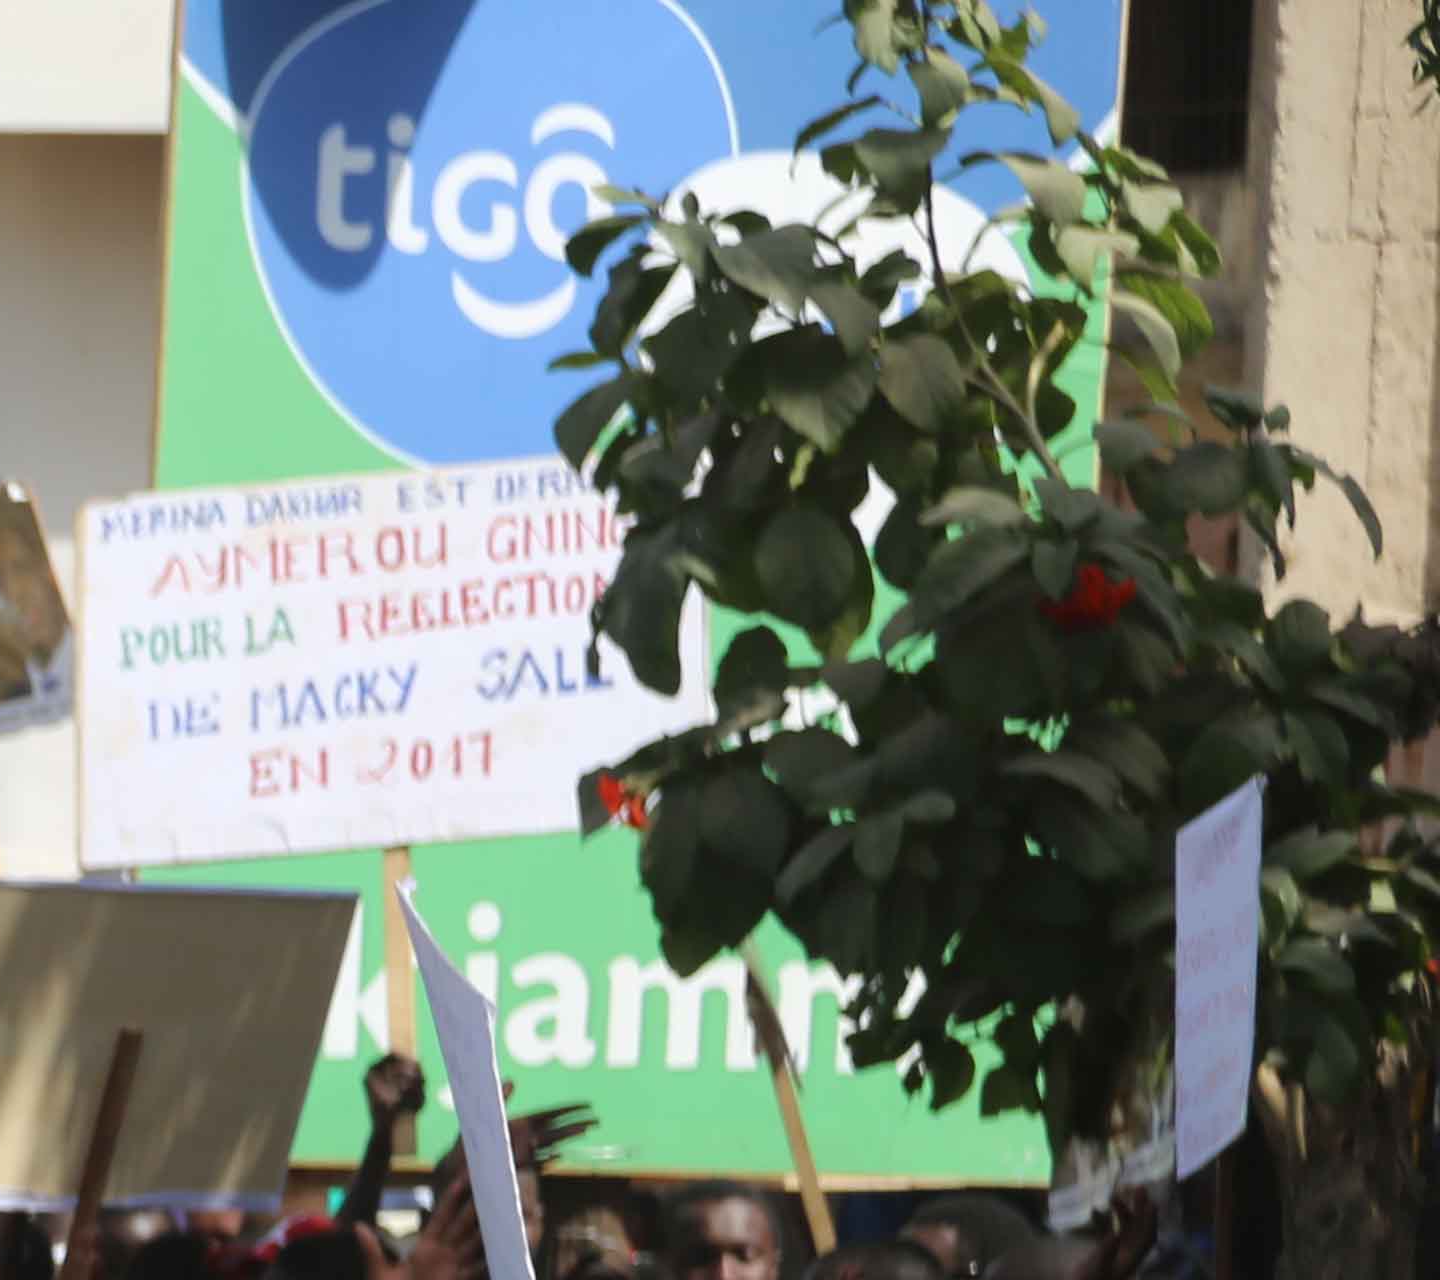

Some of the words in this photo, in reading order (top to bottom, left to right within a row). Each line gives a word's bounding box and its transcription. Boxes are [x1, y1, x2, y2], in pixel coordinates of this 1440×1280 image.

[396, 476, 473, 512] EST
[120, 614, 226, 671] POUR
[244, 604, 296, 656] LA
[148, 697, 221, 741] DE
[249, 663, 419, 733] MACKY
[247, 749, 330, 800] EN
[359, 731, 497, 787] 2017
